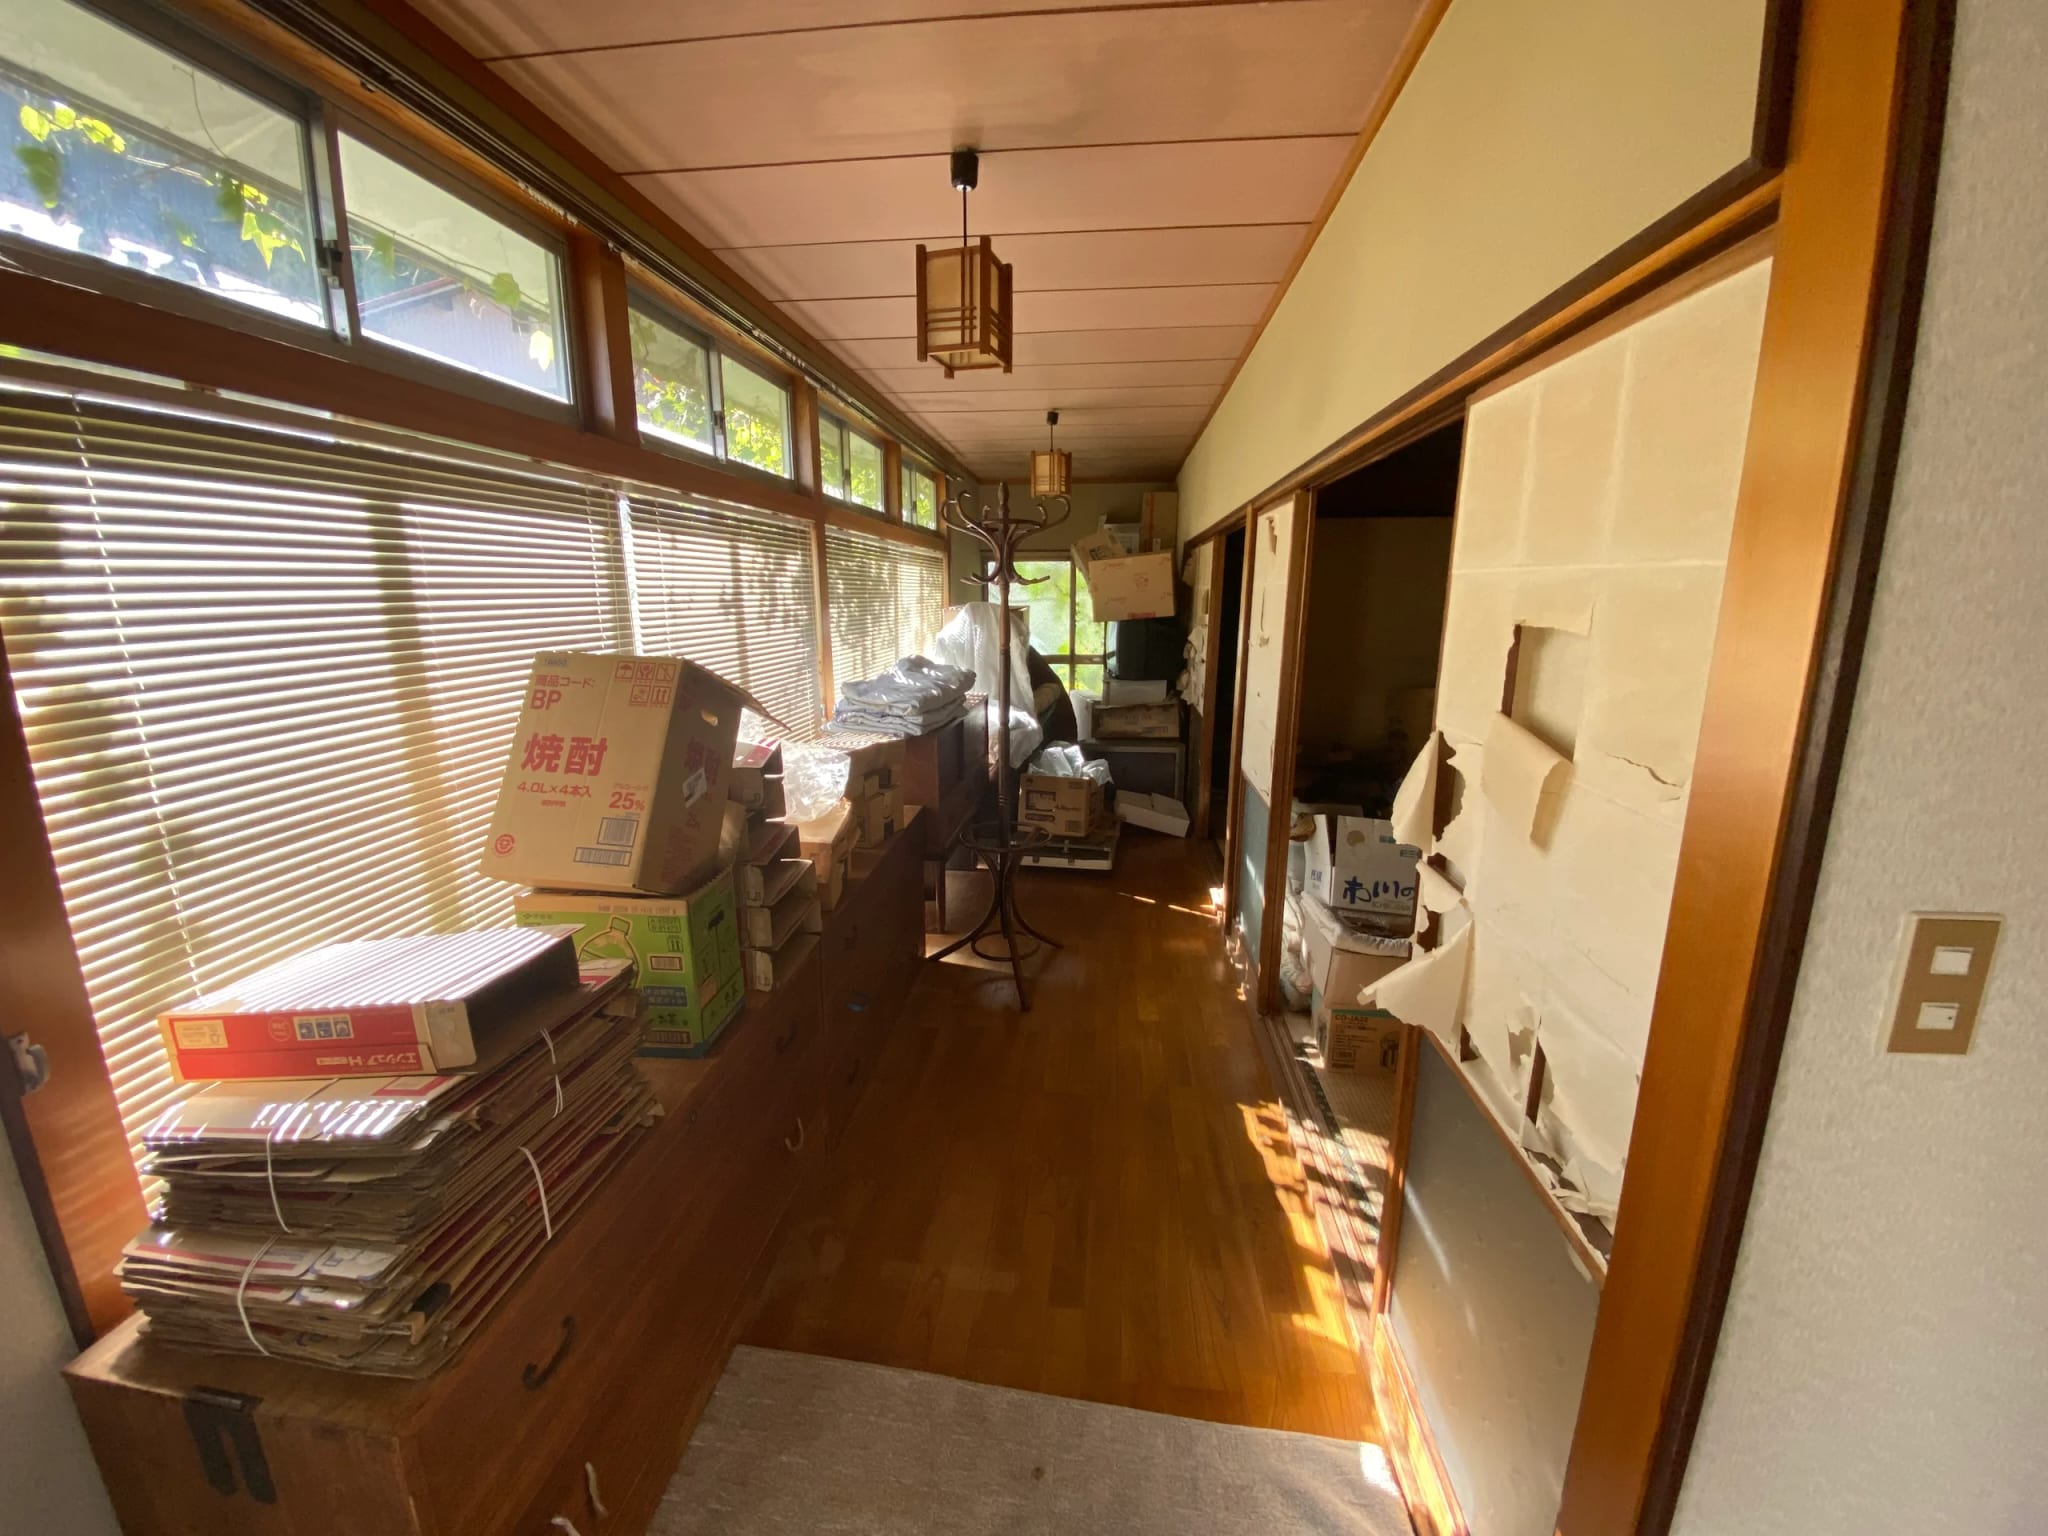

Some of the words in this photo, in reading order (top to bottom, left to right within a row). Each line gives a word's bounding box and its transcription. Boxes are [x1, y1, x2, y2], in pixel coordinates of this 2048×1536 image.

[529, 689, 562, 710] BP
[520, 733, 608, 777] 焼酎
[608, 791, 645, 811] 25%
